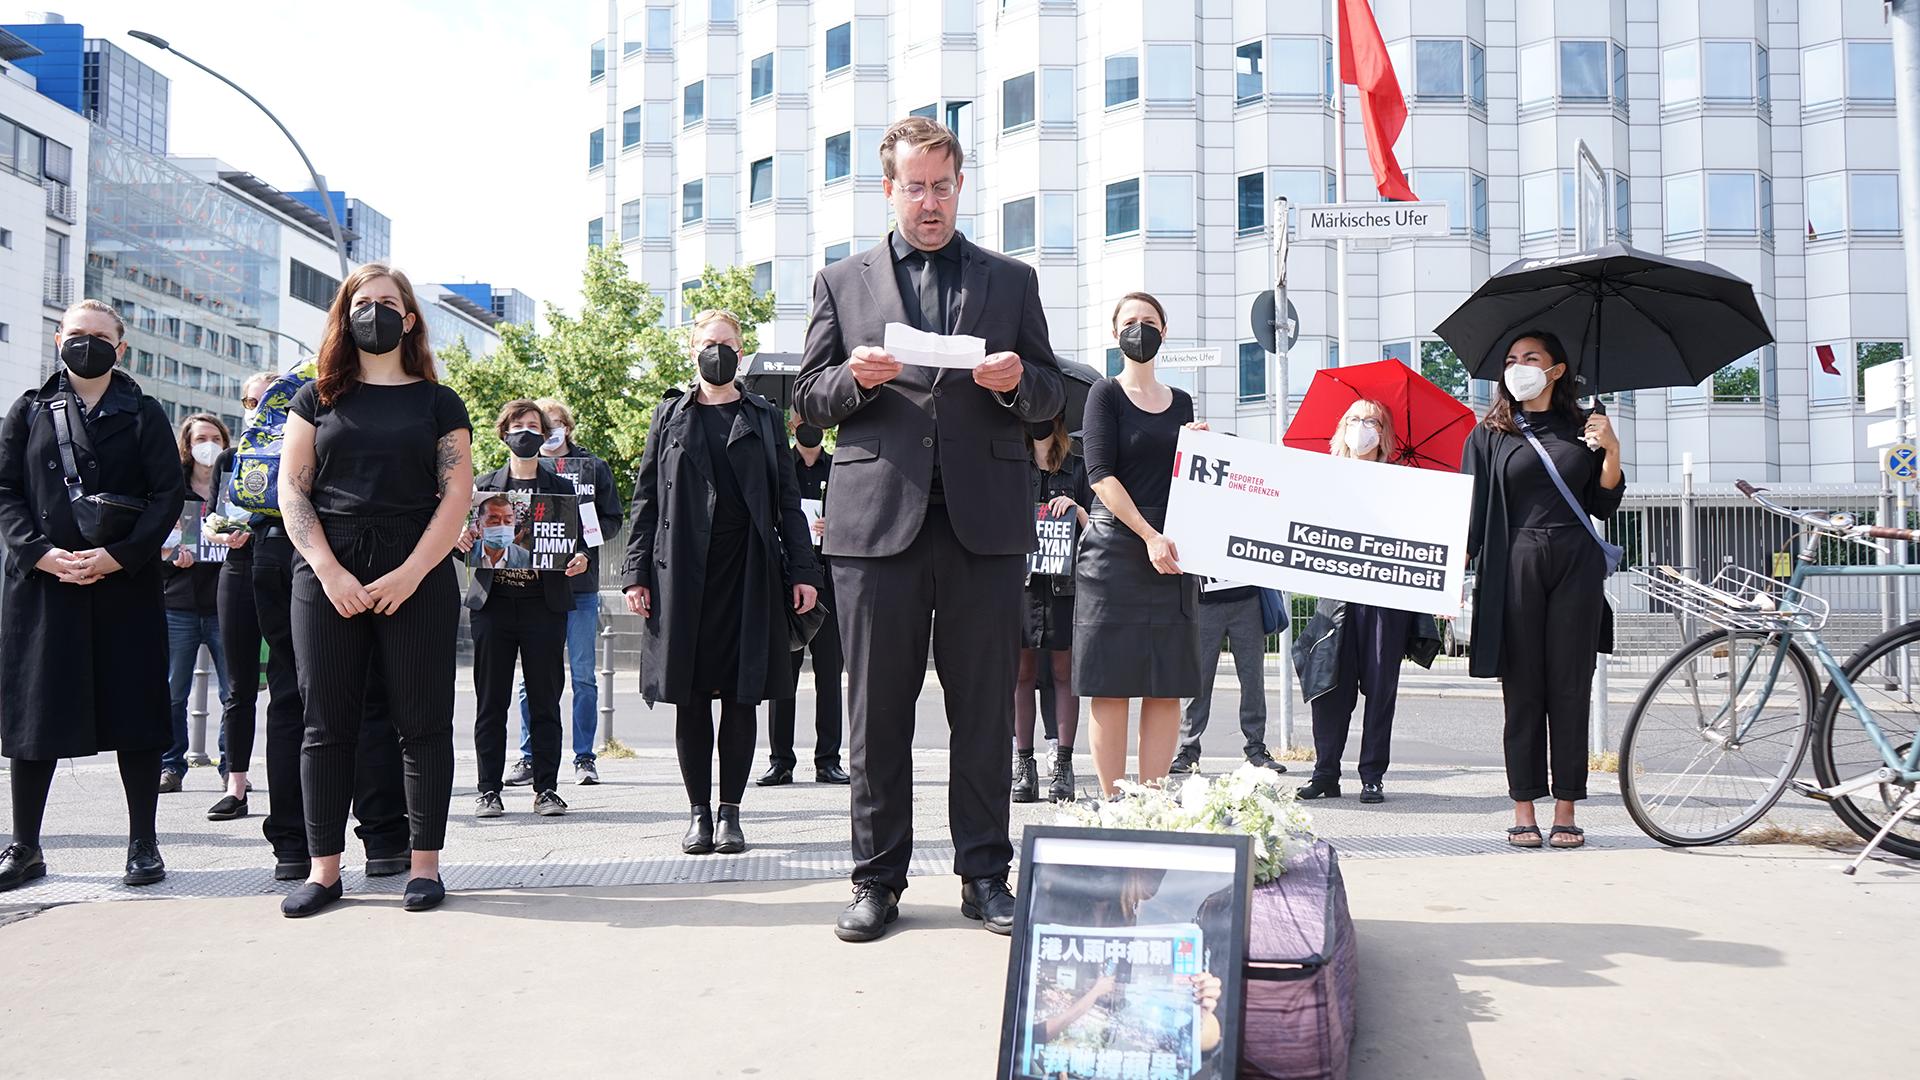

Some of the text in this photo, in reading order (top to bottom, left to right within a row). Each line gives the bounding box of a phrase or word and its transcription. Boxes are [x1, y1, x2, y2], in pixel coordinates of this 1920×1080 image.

[1311, 210, 1428, 228] Märkisches Ufer
[1161, 352, 1215, 363] Märkisches Ufer
[1189, 454, 1231, 487] RSF
[1230, 472, 1265, 486] REPORTER
[1228, 480, 1280, 498] OHNE GRENZEN
[533, 522, 566, 538] FREE
[1036, 521, 1072, 538] FREE
[533, 538, 577, 554] JIMMY
[1292, 524, 1444, 564] Keine Freiheit
[200, 547, 230, 561] LAW
[533, 554, 553, 569] LAI
[1031, 555, 1065, 574] LAW
[1231, 541, 1442, 589] ohne Pressefreiheit
[1040, 937, 1172, 965] 港人雨中痛別
